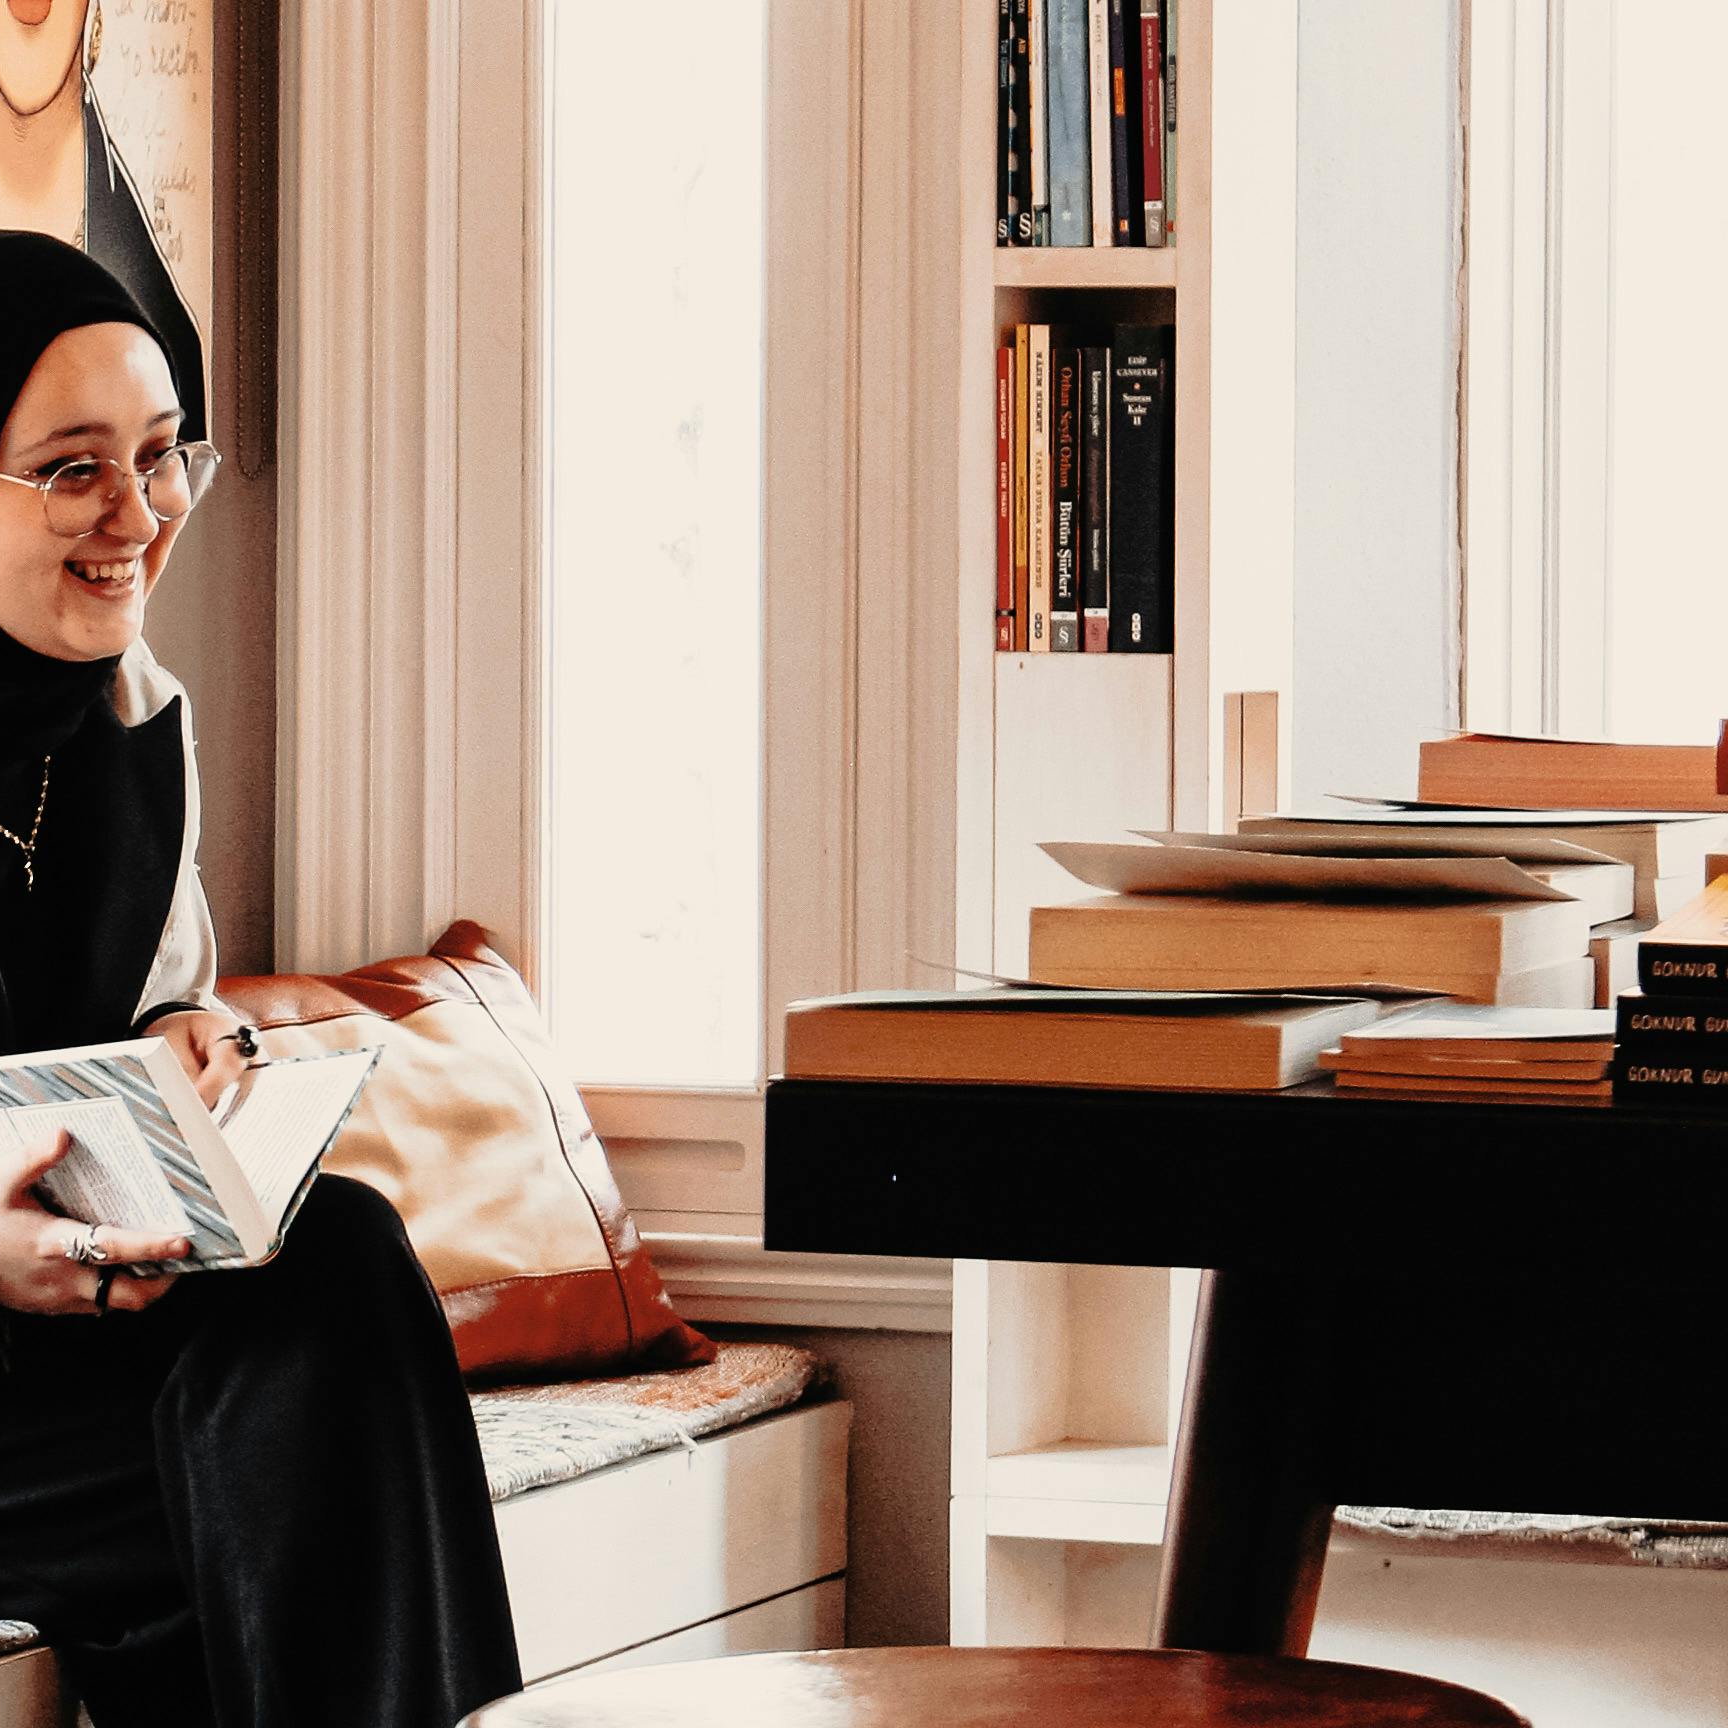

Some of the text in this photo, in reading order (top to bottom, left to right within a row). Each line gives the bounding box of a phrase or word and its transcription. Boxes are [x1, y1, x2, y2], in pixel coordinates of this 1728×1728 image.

[1057, 367, 1073, 598] Orhan Seyfi Orhon Bütün Şiirleri
